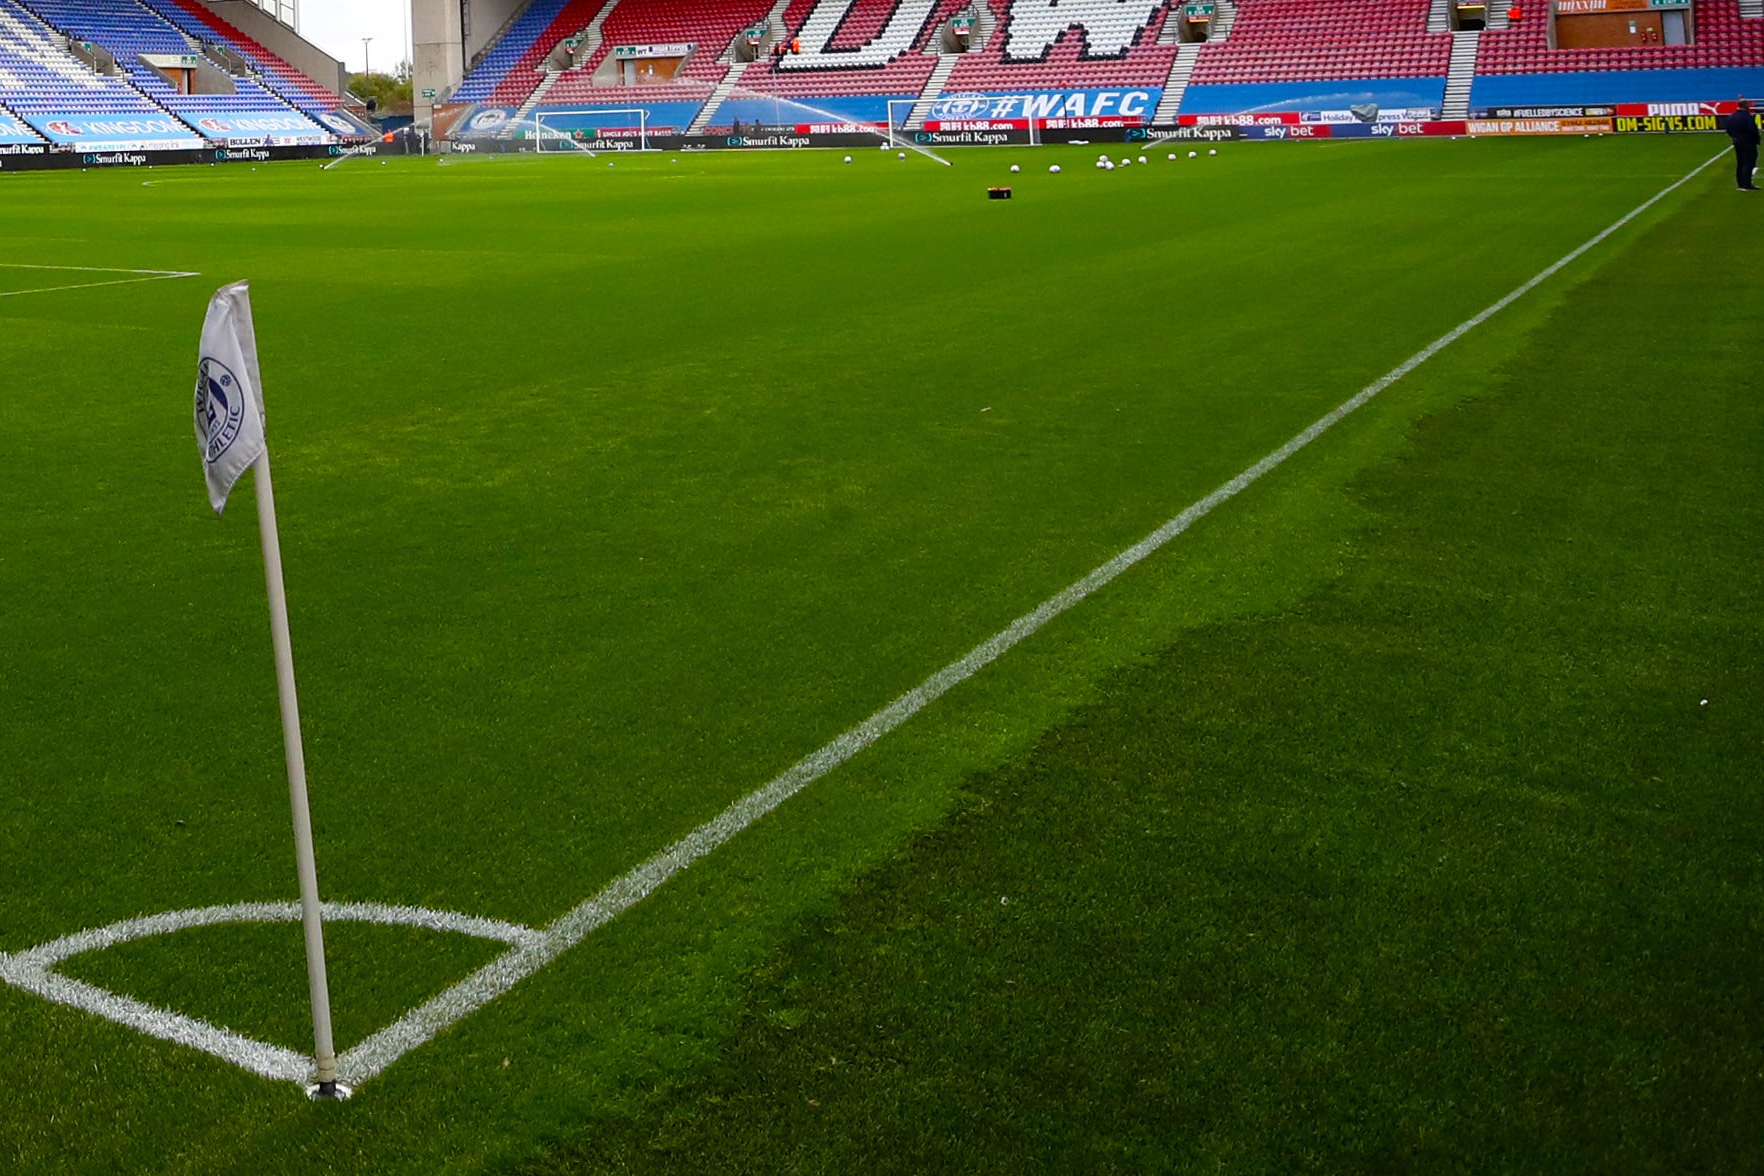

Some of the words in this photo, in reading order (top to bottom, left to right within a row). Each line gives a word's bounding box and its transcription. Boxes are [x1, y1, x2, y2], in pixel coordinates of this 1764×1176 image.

[991, 91, 1150, 119] #WAFC
[1647, 103, 1700, 116] PUMA
[1323, 113, 1353, 123] Holiday
[963, 120, 1013, 131] kb88.com
[1264, 124, 1286, 138] sky
[1290, 123, 1314, 136] bet
[1371, 122, 1393, 136] sky
[1398, 120, 1424, 134] bet
[1468, 121, 1499, 134] WIGAN
[1515, 119, 1560, 132] ALLIANCE
[932, 131, 973, 142] Smurfit
[974, 131, 1008, 144] Kappa
[1145, 125, 1191, 138] Smurfit
[1193, 125, 1232, 141] Kappa
[451, 141, 476, 153] Kappa
[742, 136, 778, 146] Smurfit
[779, 135, 810, 147] Kappa
[22, 144, 45, 155] Kappa
[95, 153, 123, 163] Smurfit
[123, 153, 146, 166] Kappa
